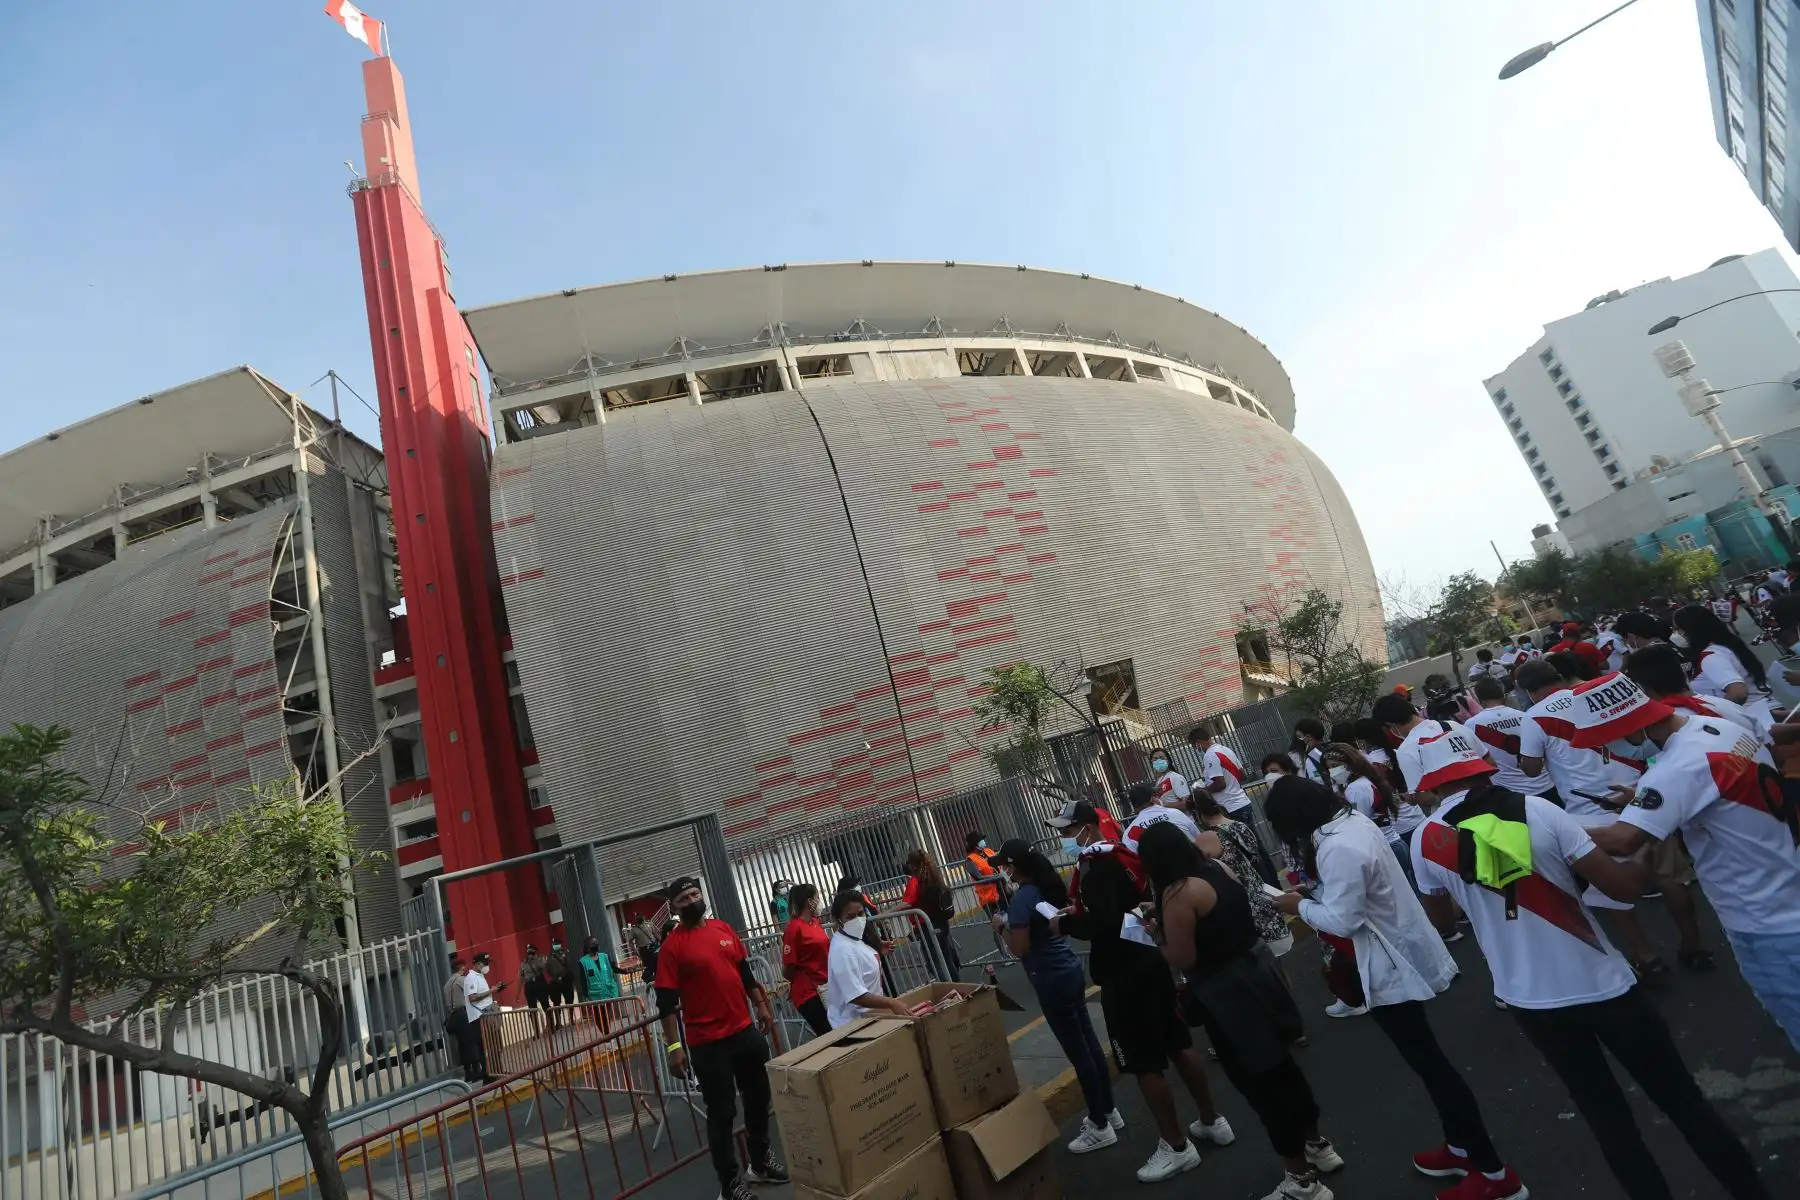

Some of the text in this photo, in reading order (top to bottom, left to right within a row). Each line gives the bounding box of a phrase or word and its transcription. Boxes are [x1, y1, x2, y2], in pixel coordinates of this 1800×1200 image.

[1609, 697, 1638, 716] SIEMPRE
[1139, 813, 1170, 829] FLORES
[1112, 1039, 1127, 1067] adidas
